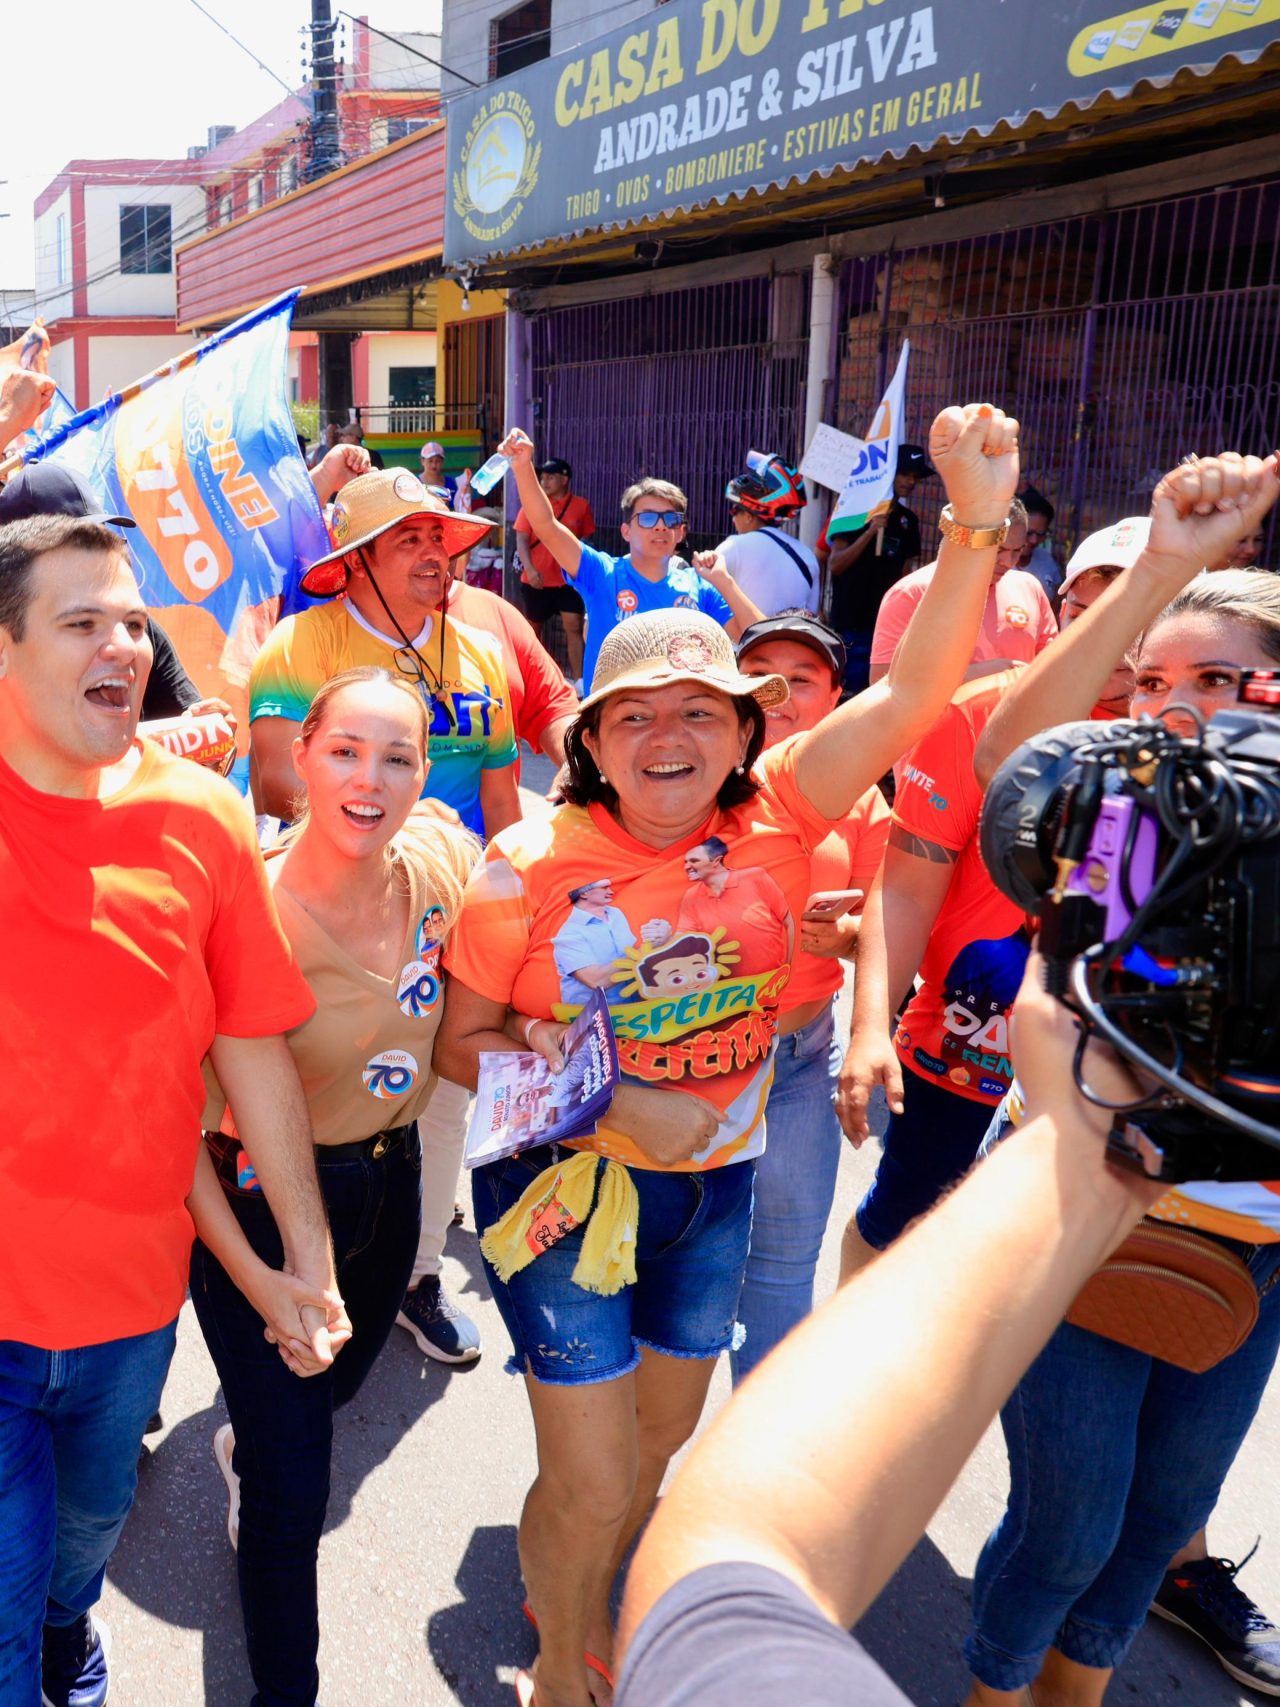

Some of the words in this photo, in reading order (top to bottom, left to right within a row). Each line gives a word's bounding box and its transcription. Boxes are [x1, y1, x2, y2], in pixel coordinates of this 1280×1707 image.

[554, 17, 684, 128] CASA
[696, 0, 780, 76] DO
[594, 74, 753, 174] ANDRADE
[757, 67, 783, 121] &
[792, 6, 938, 111] SILVA
[461, 104, 488, 163] CASA
[489, 91, 506, 114] DO
[507, 90, 536, 138] TRIGO
[566, 188, 601, 221] TRIGO
[616, 174, 650, 208] OVOS
[665, 138, 767, 195] BOMBONIERE
[783, 108, 865, 163] ESTIVAS
[869, 96, 902, 138] EM
[906, 72, 983, 128] GERAL
[928, 791, 949, 811] 70
[398, 974, 439, 1018] 70
[955, 989, 999, 1012] PRE
[942, 1000, 1010, 1054] DA
[368, 1064, 413, 1095] 70
[962, 1048, 1015, 1079] REN
